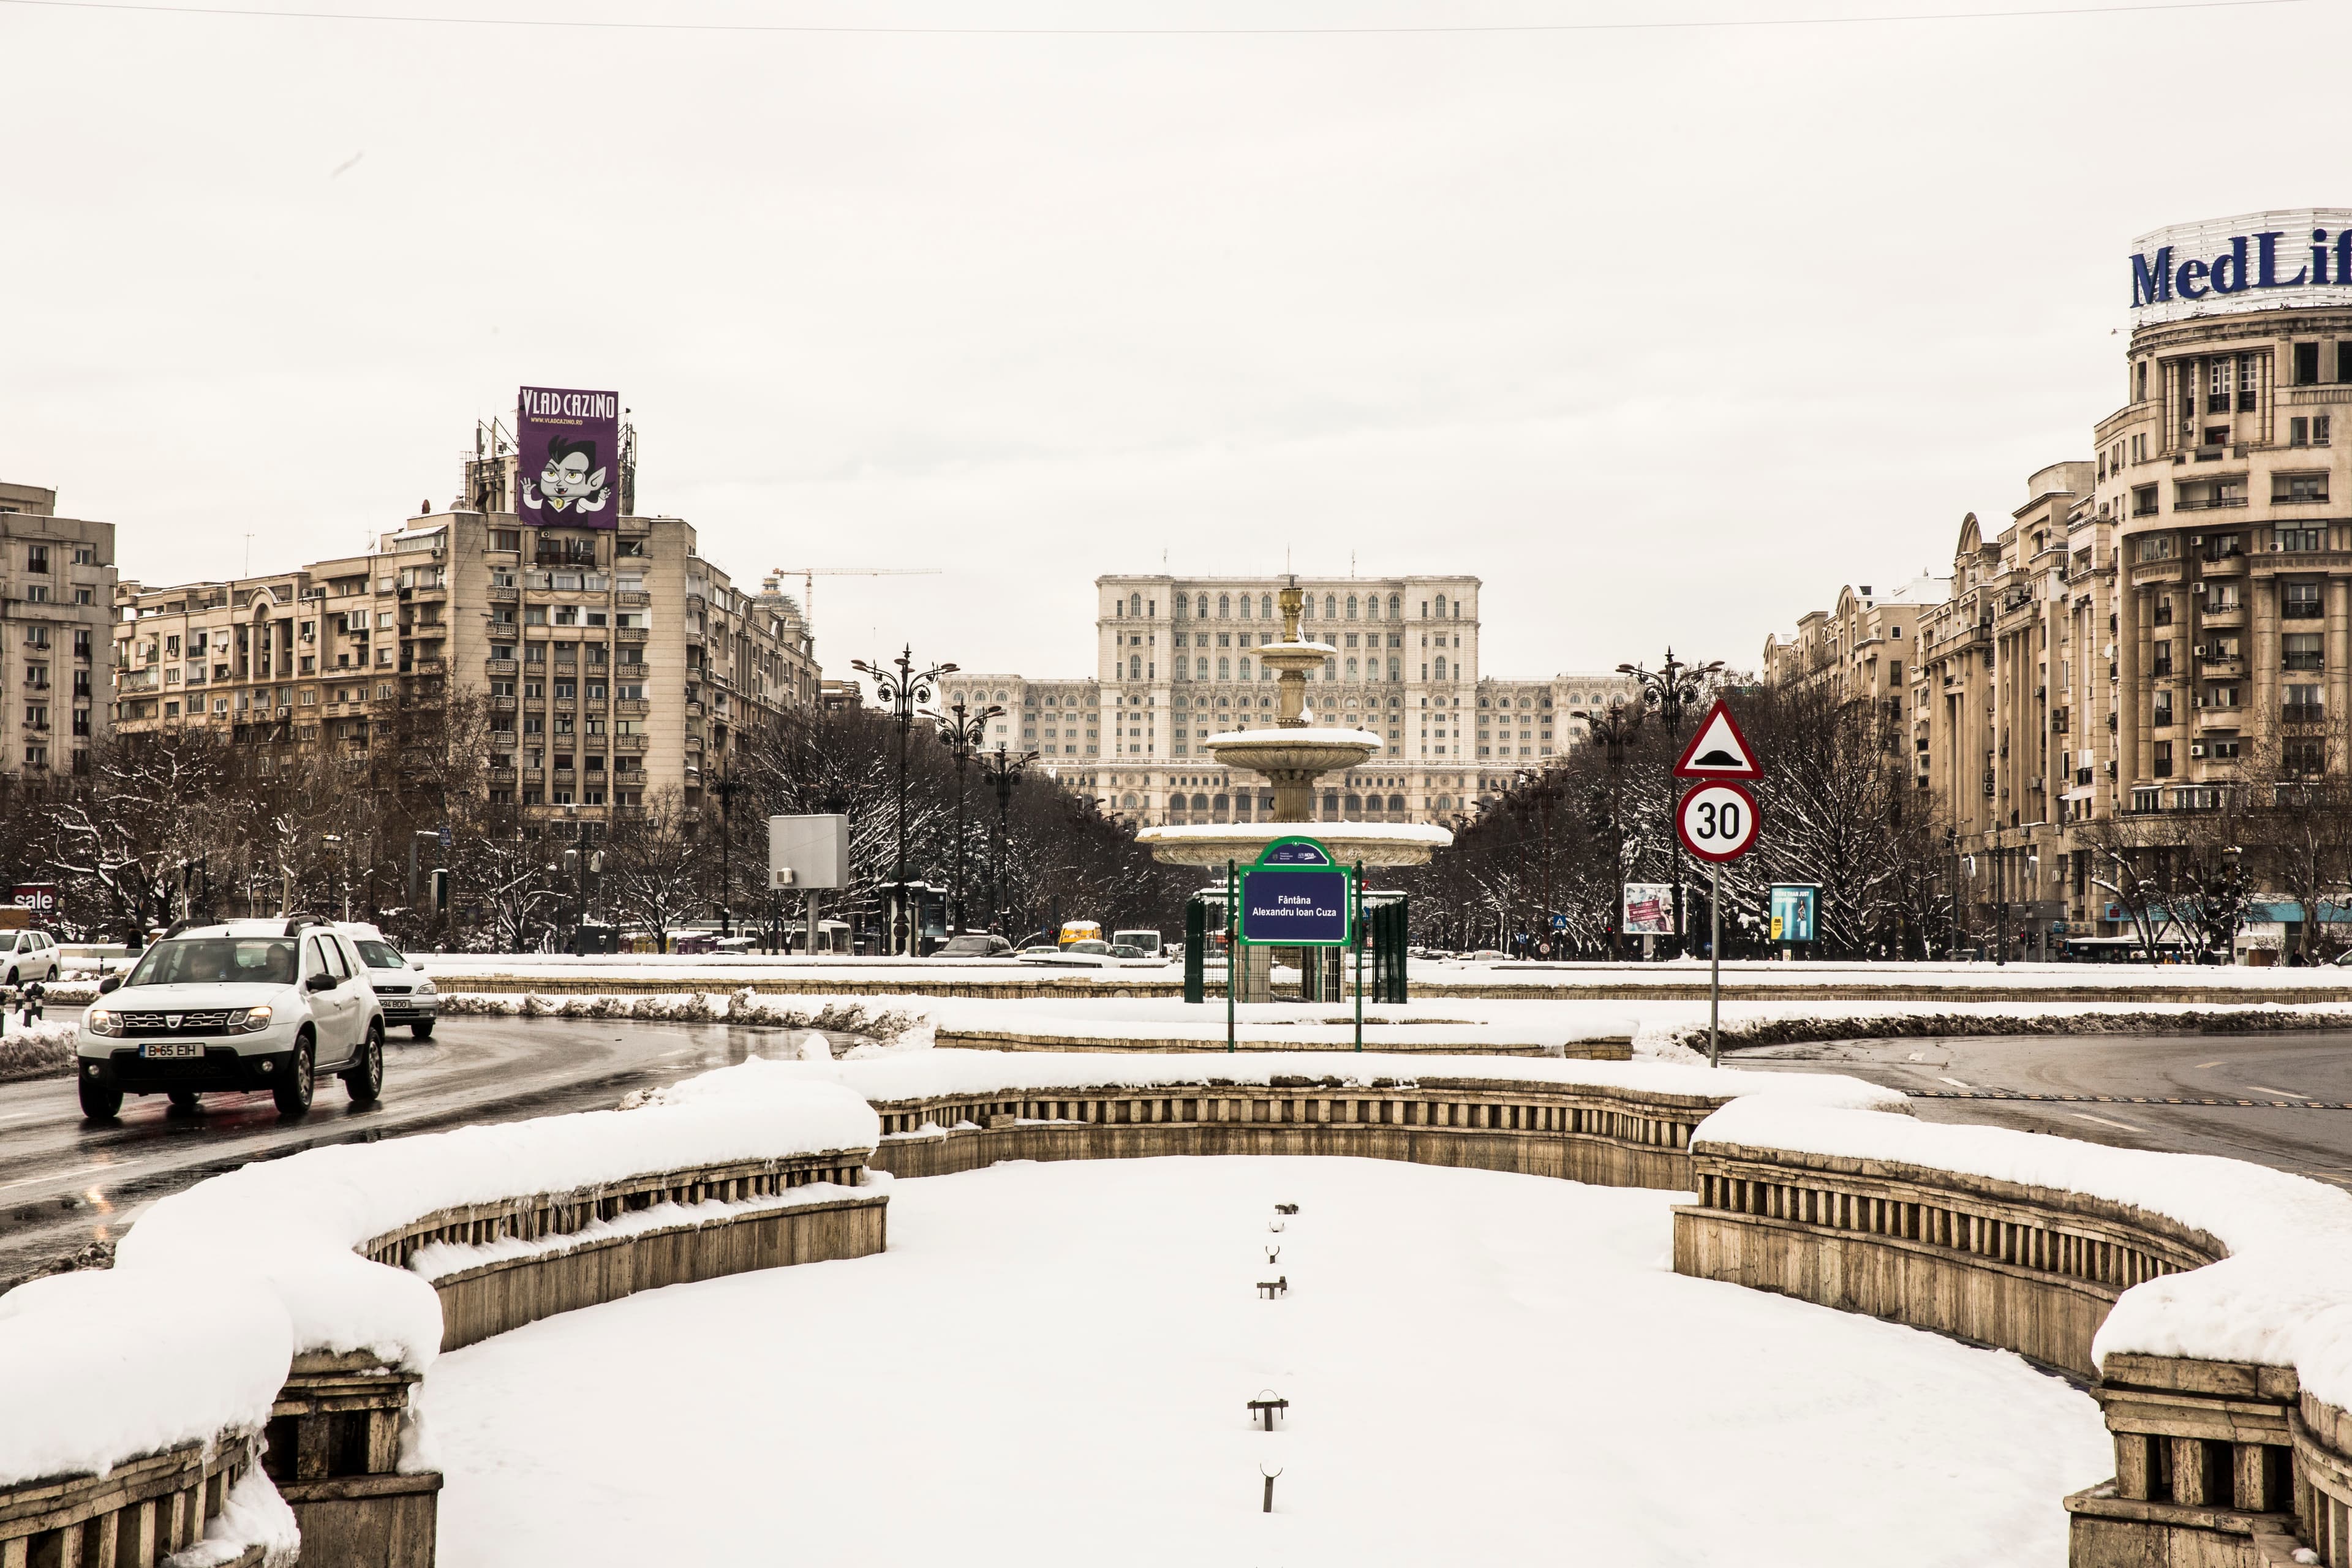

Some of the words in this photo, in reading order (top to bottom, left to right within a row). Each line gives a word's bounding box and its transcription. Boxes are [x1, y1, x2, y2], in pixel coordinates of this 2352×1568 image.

[522, 389, 561, 418] VLAD
[564, 393, 615, 421] CAZINO
[1697, 802, 1740, 840] 30
[15, 891, 53, 909] sale
[1278, 895, 1311, 905] Fântâna
[1253, 907, 1294, 916] Alexandru
[1296, 908, 1314, 916] Ioan
[1316, 908, 1336, 916] Cuza
[148, 1046, 156, 1056] B
[160, 1046, 173, 1056] 65
